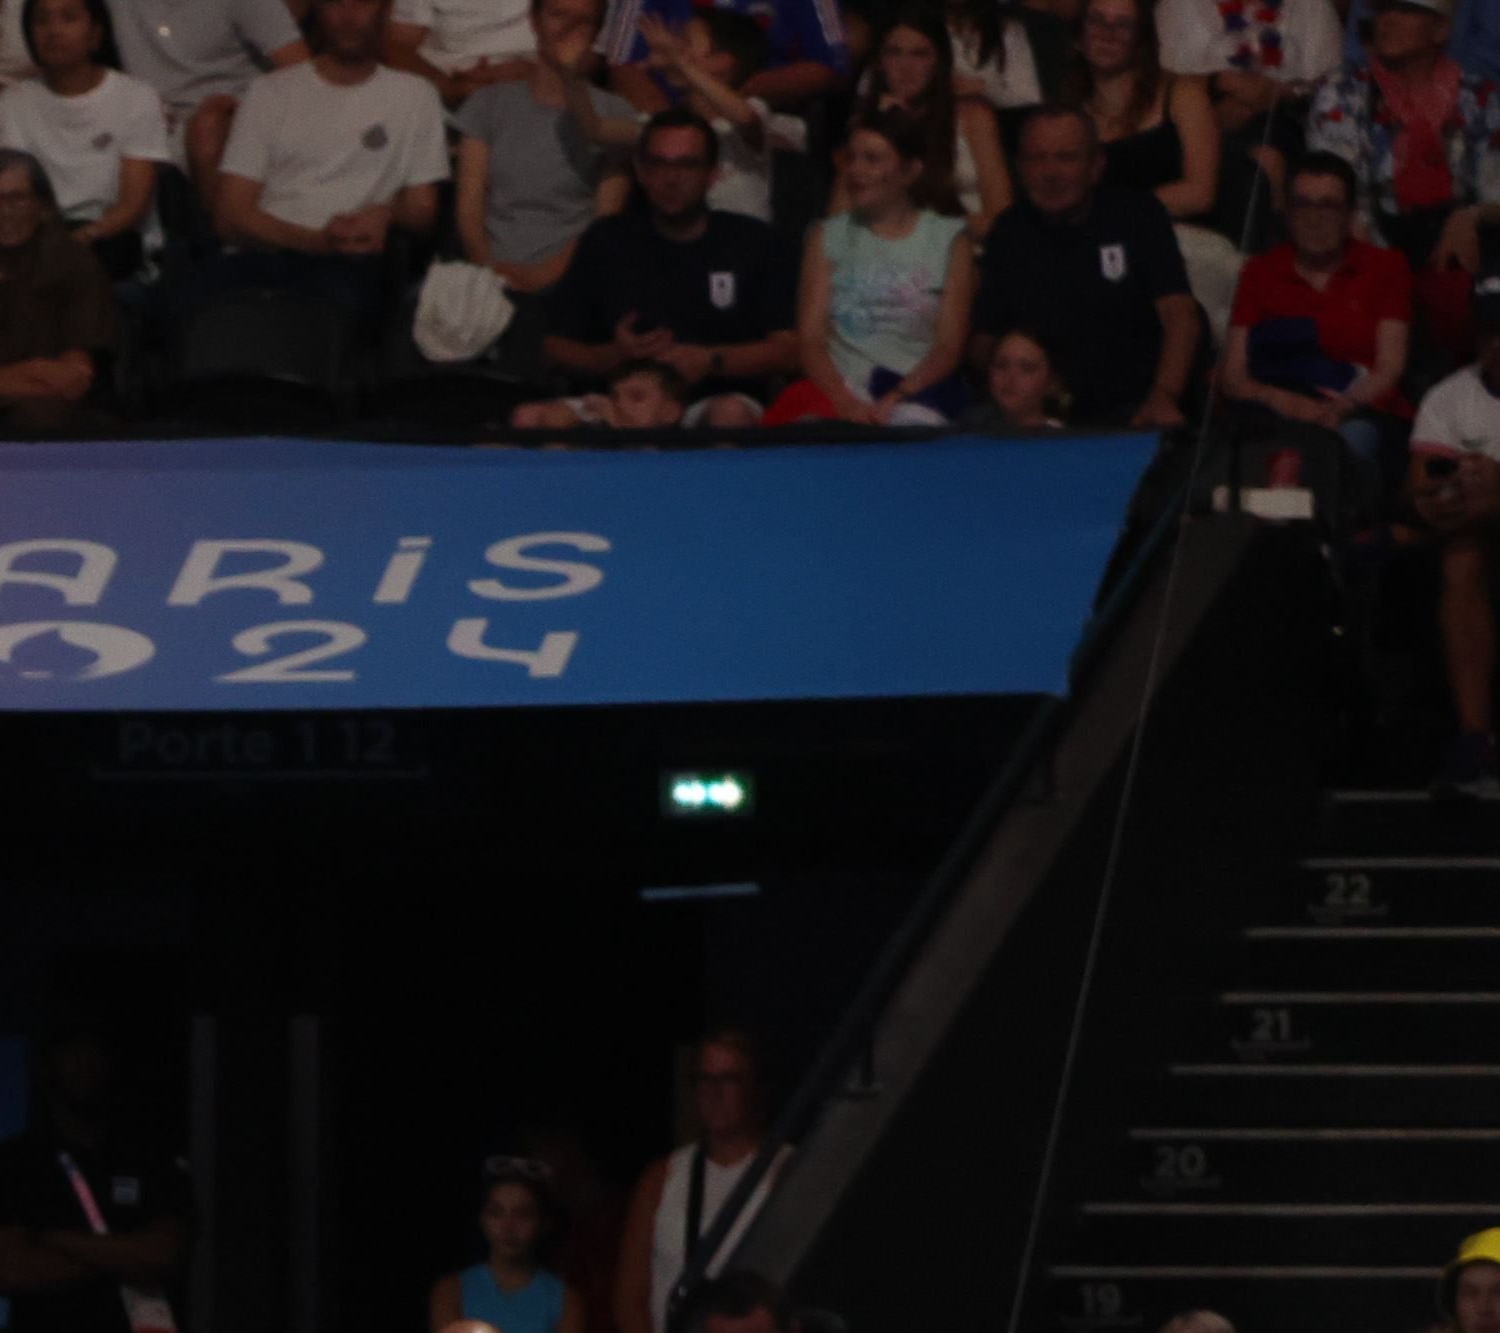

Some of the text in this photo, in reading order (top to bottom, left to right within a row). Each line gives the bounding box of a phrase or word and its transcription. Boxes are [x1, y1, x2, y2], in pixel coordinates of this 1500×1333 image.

[118, 719, 276, 765] Porte
[1325, 872, 1370, 905] 22
[1251, 1008, 1291, 1041] 21
[1152, 1145, 1207, 1178] 20
